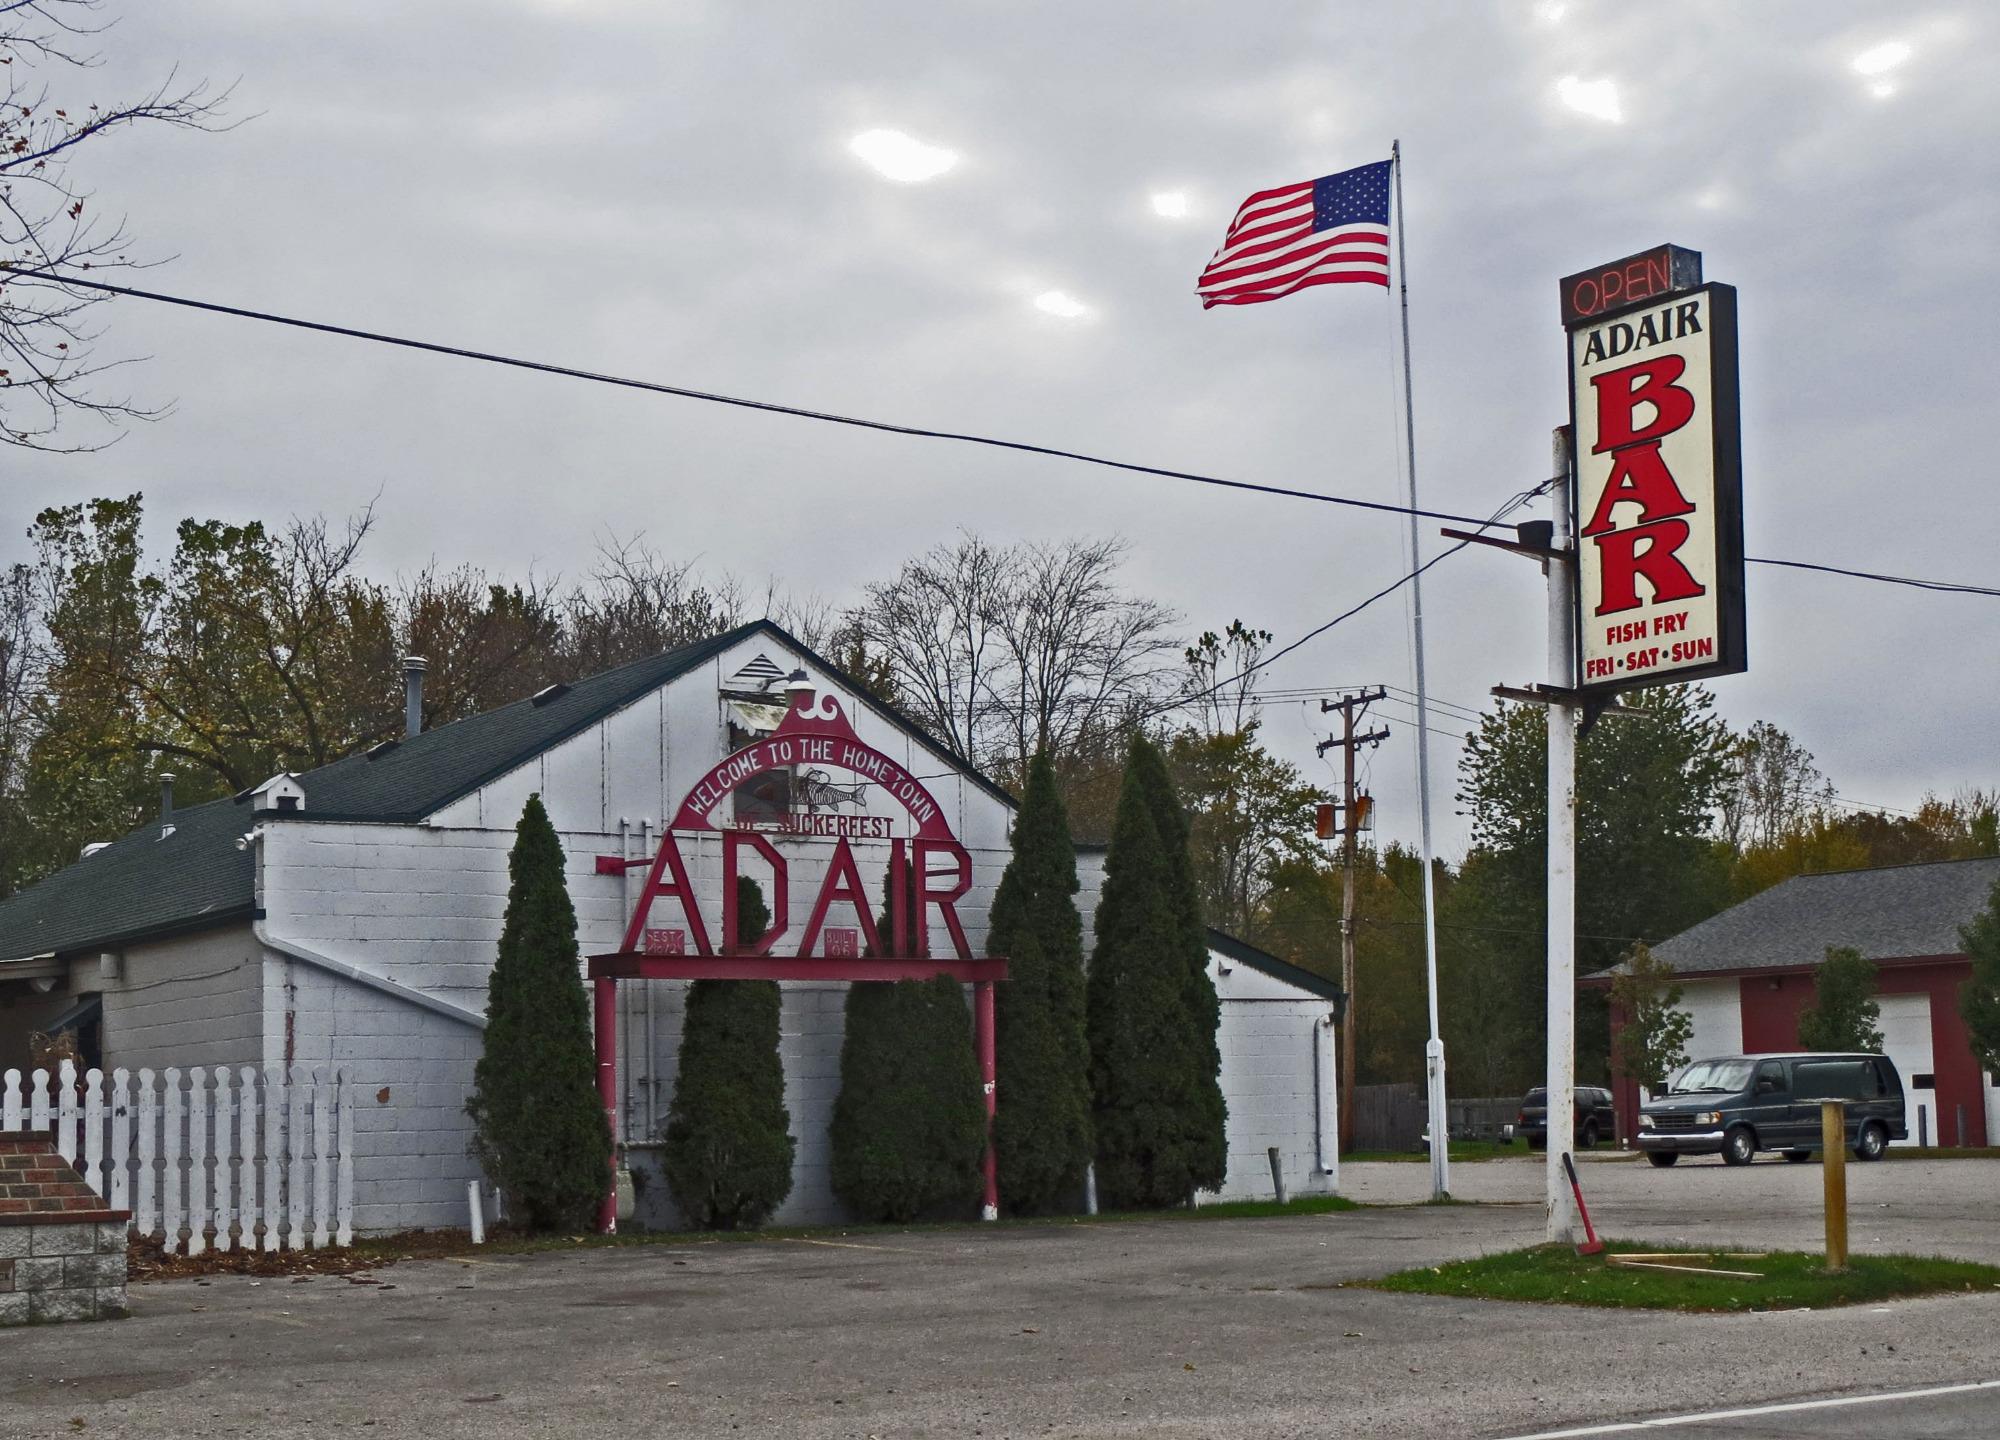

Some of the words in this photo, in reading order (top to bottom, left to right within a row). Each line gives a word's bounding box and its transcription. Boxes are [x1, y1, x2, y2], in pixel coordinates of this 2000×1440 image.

[1574, 254, 1669, 316] OPEN
[1582, 300, 1703, 366] ADAIR
[1581, 354, 1706, 617] BAR
[1606, 620, 1647, 645] FISH
[1654, 612, 1689, 635] FRY
[687, 749, 762, 815] WELCOME
[768, 741, 791, 763] TO
[800, 738, 834, 761] THE
[778, 812, 894, 838] SUCKERFEST
[619, 829, 973, 959] ADAIR
[826, 930, 857, 944] BUILT
